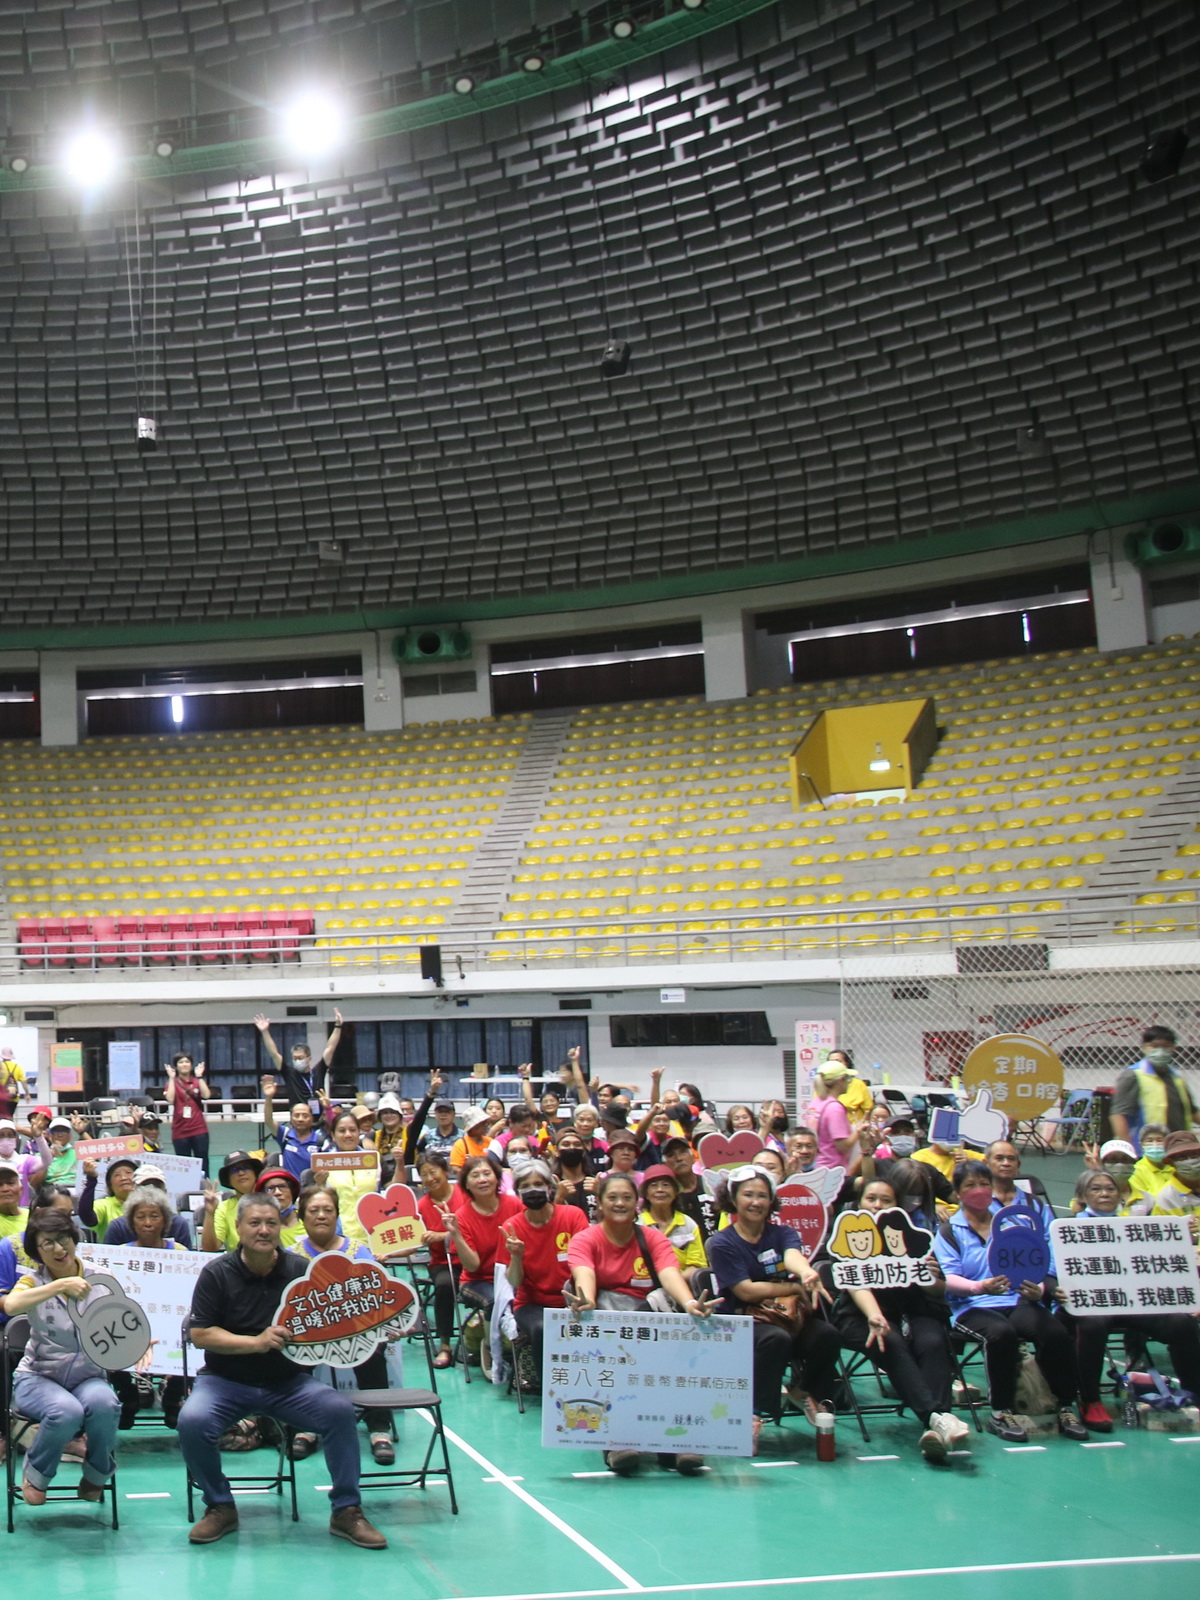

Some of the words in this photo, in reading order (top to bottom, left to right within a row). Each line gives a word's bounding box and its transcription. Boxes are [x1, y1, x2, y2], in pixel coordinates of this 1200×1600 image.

[993, 1056, 1037, 1075] 定期
[1016, 1082, 1059, 1100] 口腔
[777, 1196, 819, 1206] 安心專線
[380, 1224, 416, 1245] 理解
[999, 1248, 1044, 1269] 8KG
[837, 1260, 932, 1286] 運動防老
[289, 1270, 382, 1314] 文化健康站
[286, 1290, 396, 1336] 溫暖你我的心
[90, 1310, 142, 1355] 5KG
[551, 1367, 615, 1388] 第八名
